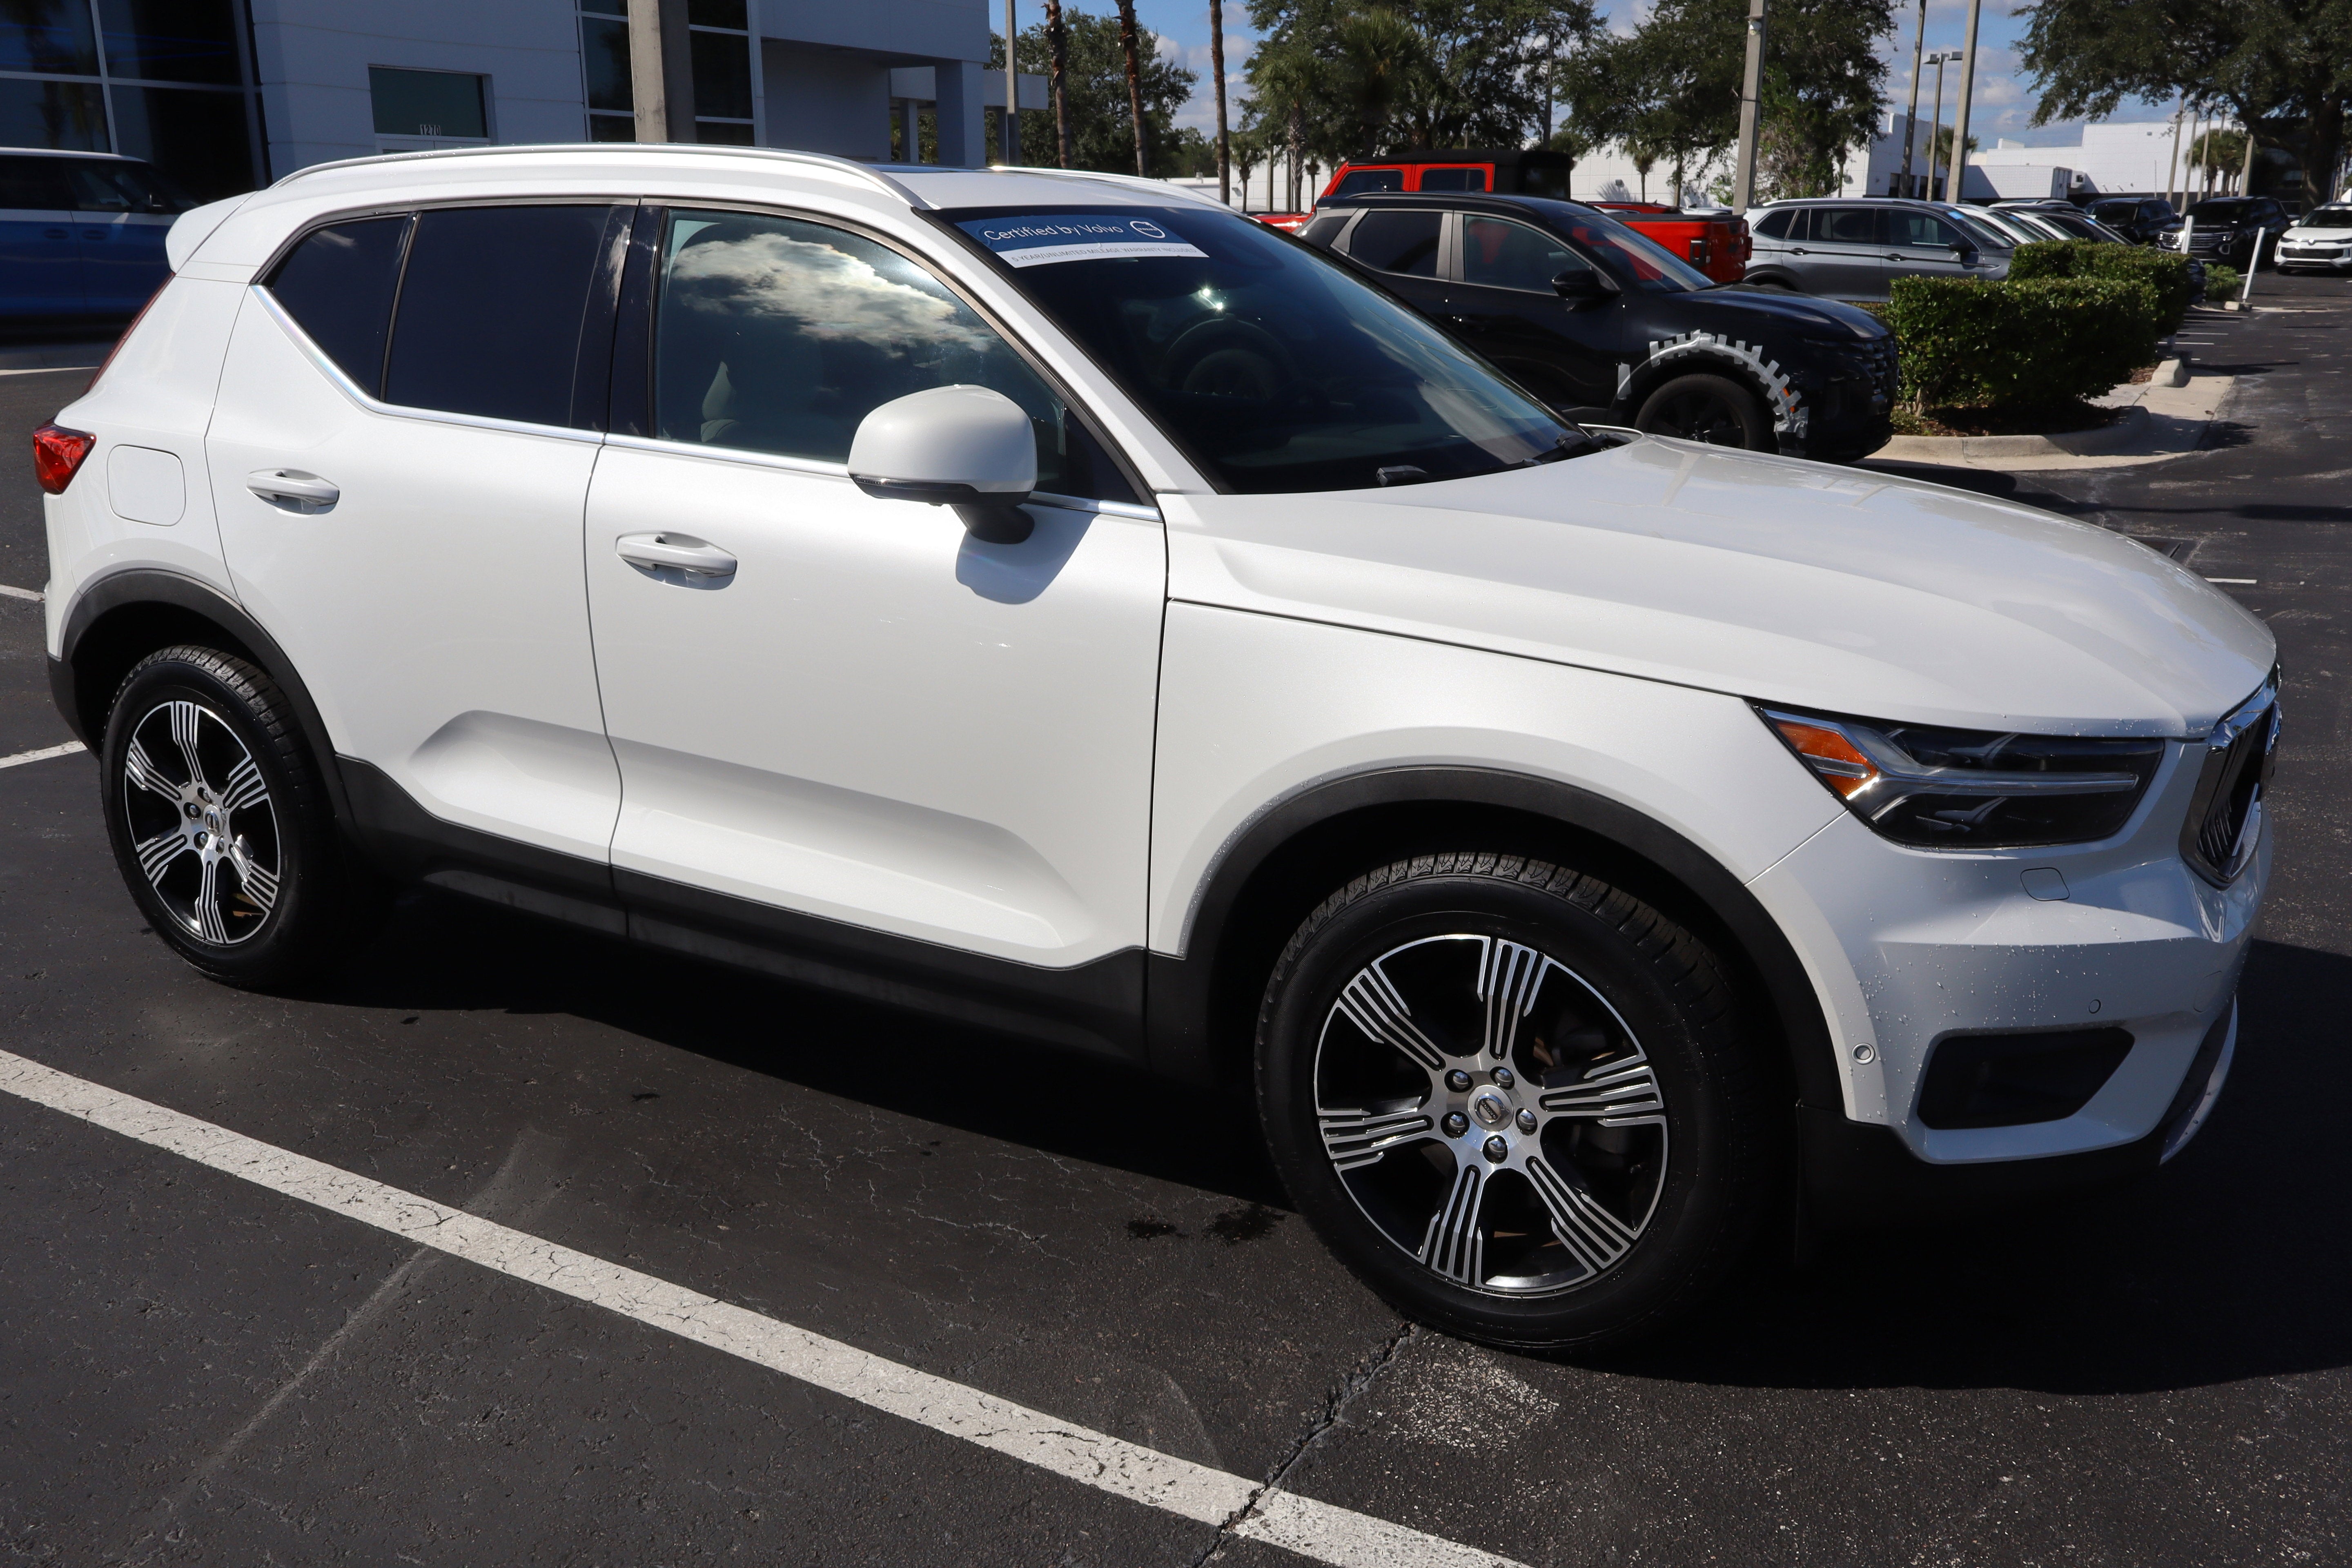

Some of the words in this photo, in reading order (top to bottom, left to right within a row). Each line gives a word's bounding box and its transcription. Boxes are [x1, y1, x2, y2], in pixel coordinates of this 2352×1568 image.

[421, 125, 440, 136] 1270
[984, 225, 1058, 240] Certified
[1055, 225, 1081, 236] by
[1077, 224, 1124, 233] Volvo
[1018, 250, 1087, 261] YEAR/UNLIMITED
